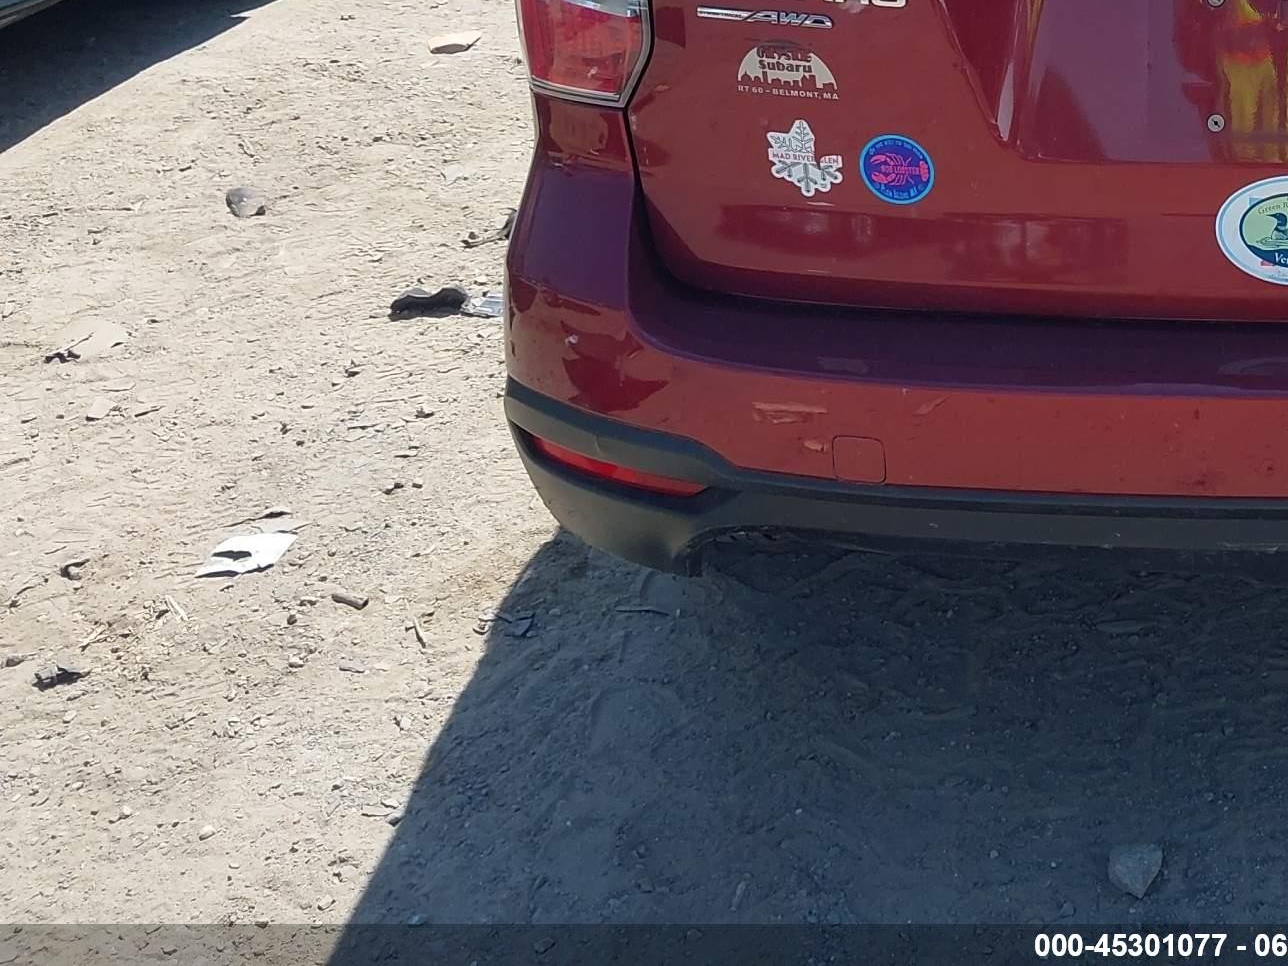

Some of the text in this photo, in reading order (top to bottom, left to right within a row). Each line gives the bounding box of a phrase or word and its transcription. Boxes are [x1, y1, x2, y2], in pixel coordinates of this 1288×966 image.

[746, 10, 833, 29] AWD
[758, 60, 813, 73] Subaru
[772, 88, 822, 99] BELMONT,
[1257, 204, 1281, 215] Green
